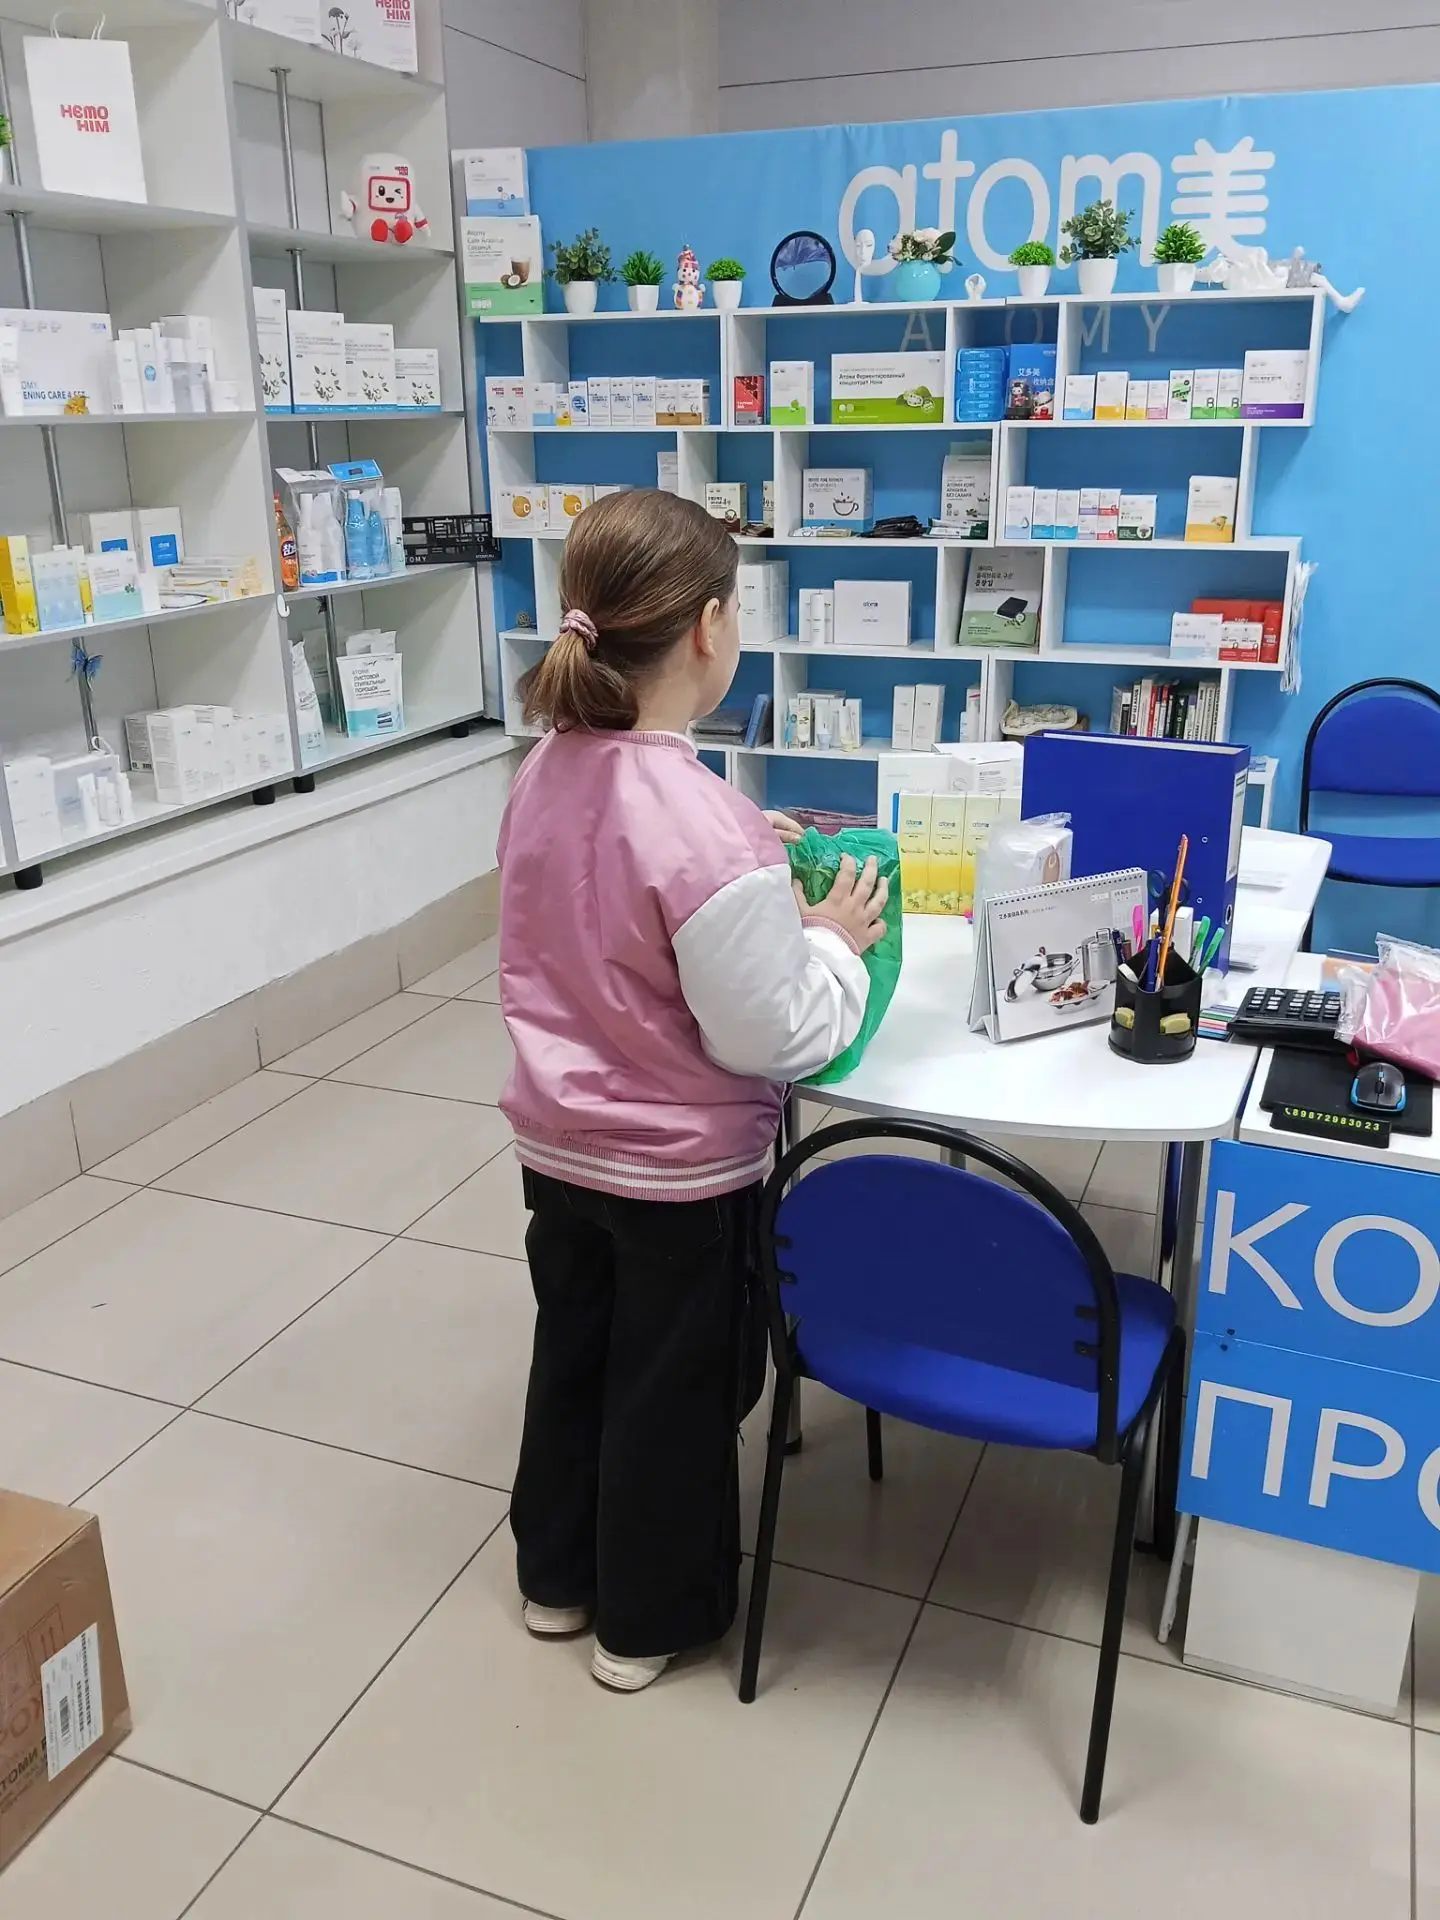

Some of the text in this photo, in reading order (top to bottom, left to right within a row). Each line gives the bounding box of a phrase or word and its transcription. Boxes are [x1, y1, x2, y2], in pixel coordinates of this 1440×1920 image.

[385, 9, 411, 21] HIM
[60, 104, 109, 120] HEMO
[76, 119, 110, 133] HIM
[47, 390, 67, 400] CARE
[1292, 1108, 1380, 1131] 89872983023
[1190, 1379, 1440, 1533] ПР
